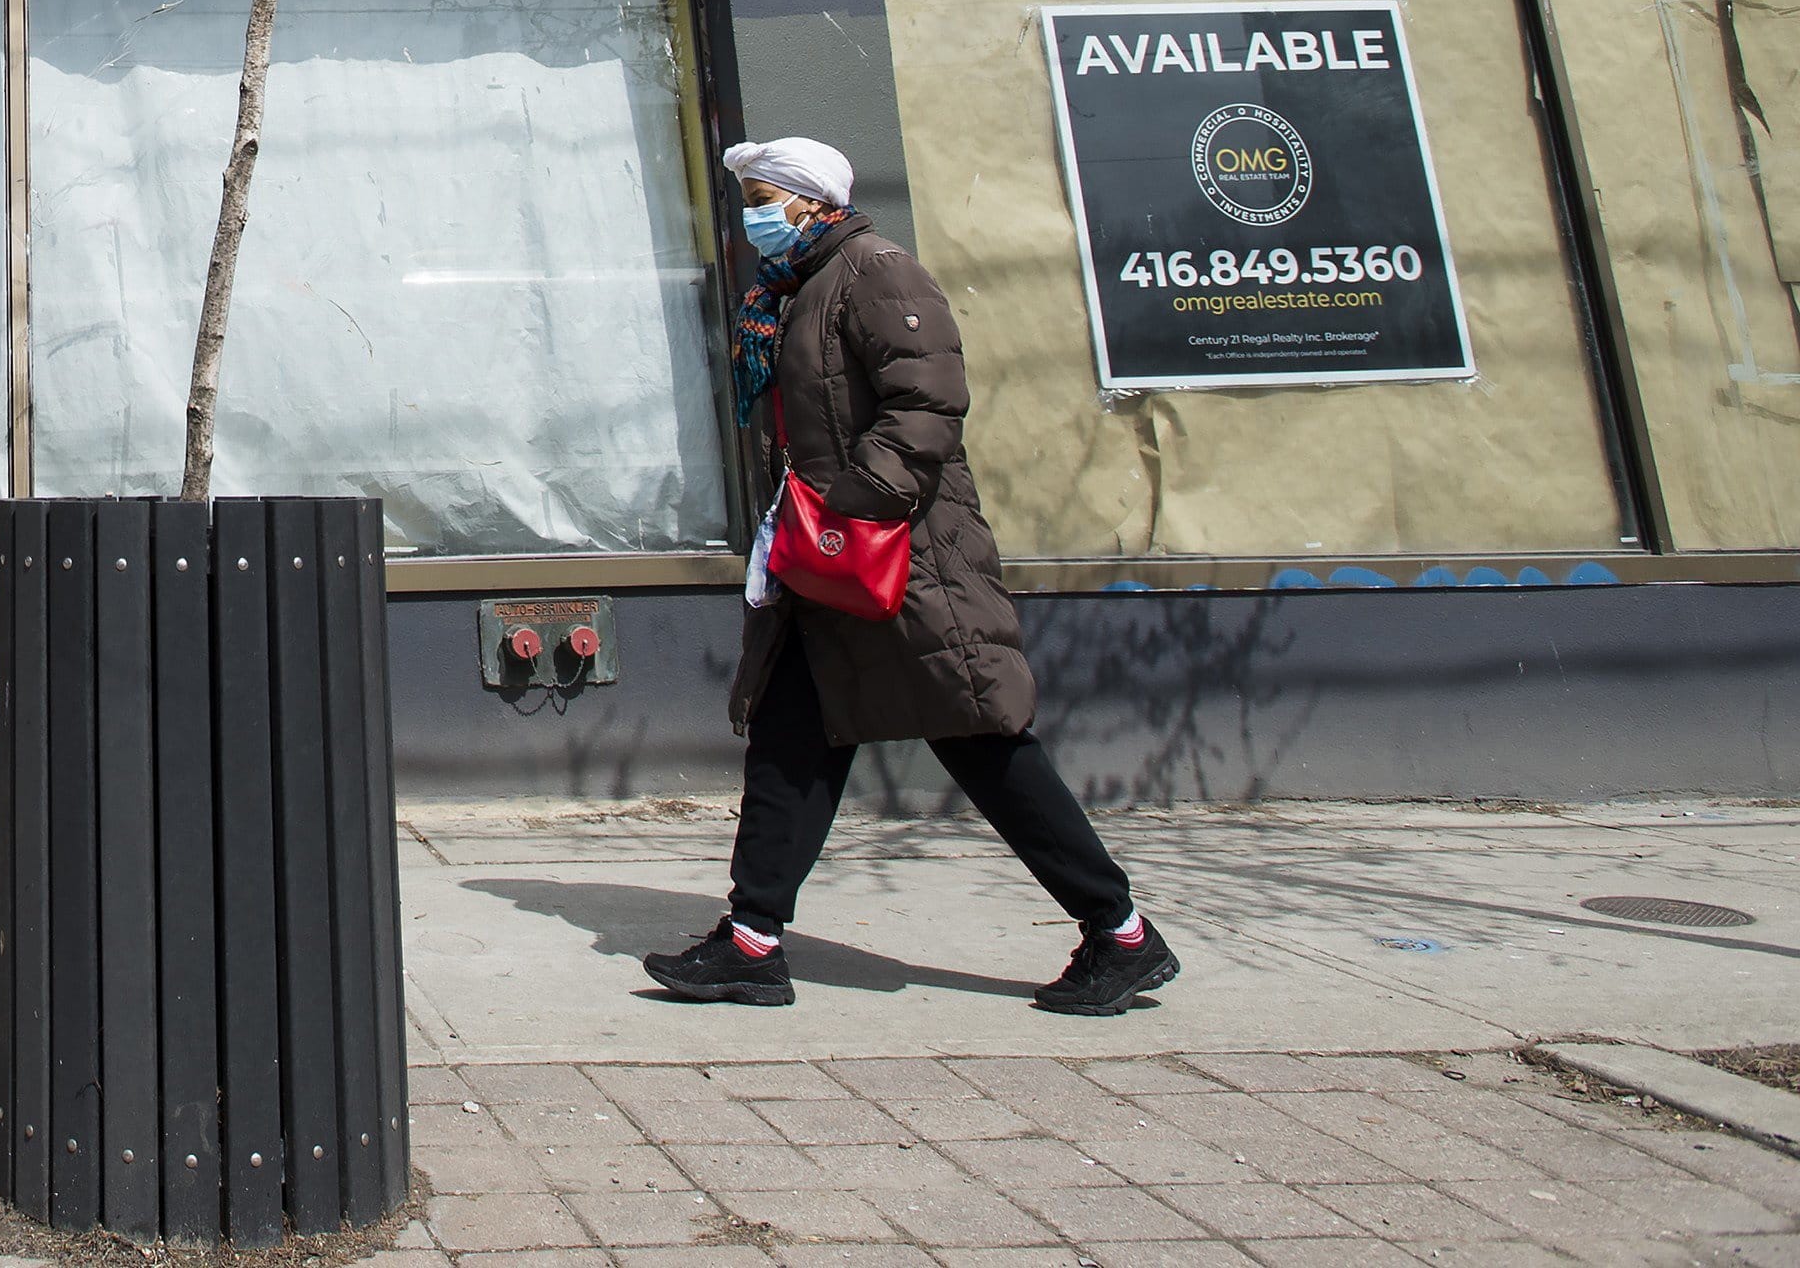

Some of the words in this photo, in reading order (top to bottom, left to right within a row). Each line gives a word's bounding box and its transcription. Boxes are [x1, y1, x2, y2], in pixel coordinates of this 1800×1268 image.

[1075, 29, 1391, 75] AVAILABLE
[1195, 111, 1231, 181] COMMERCIAL
[1255, 109, 1309, 178] HOSPITALITY
[1216, 148, 1287, 172] OMG
[1240, 173, 1268, 181] ESTATE
[1220, 197, 1300, 222] INVESTMENTS
[1118, 245, 1423, 288] 416.849.5360
[1173, 289, 1383, 314] omgrealestate.com
[1188, 335, 1228, 347] Century
[1230, 335, 1240, 344] 21
[1243, 334, 1271, 345] Regal
[1273, 333, 1303, 344] Realty
[1305, 333, 1322, 342] Inc.
[820, 534, 841, 551] MK
[498, 600, 599, 615] AUTO-SPRINKLER
